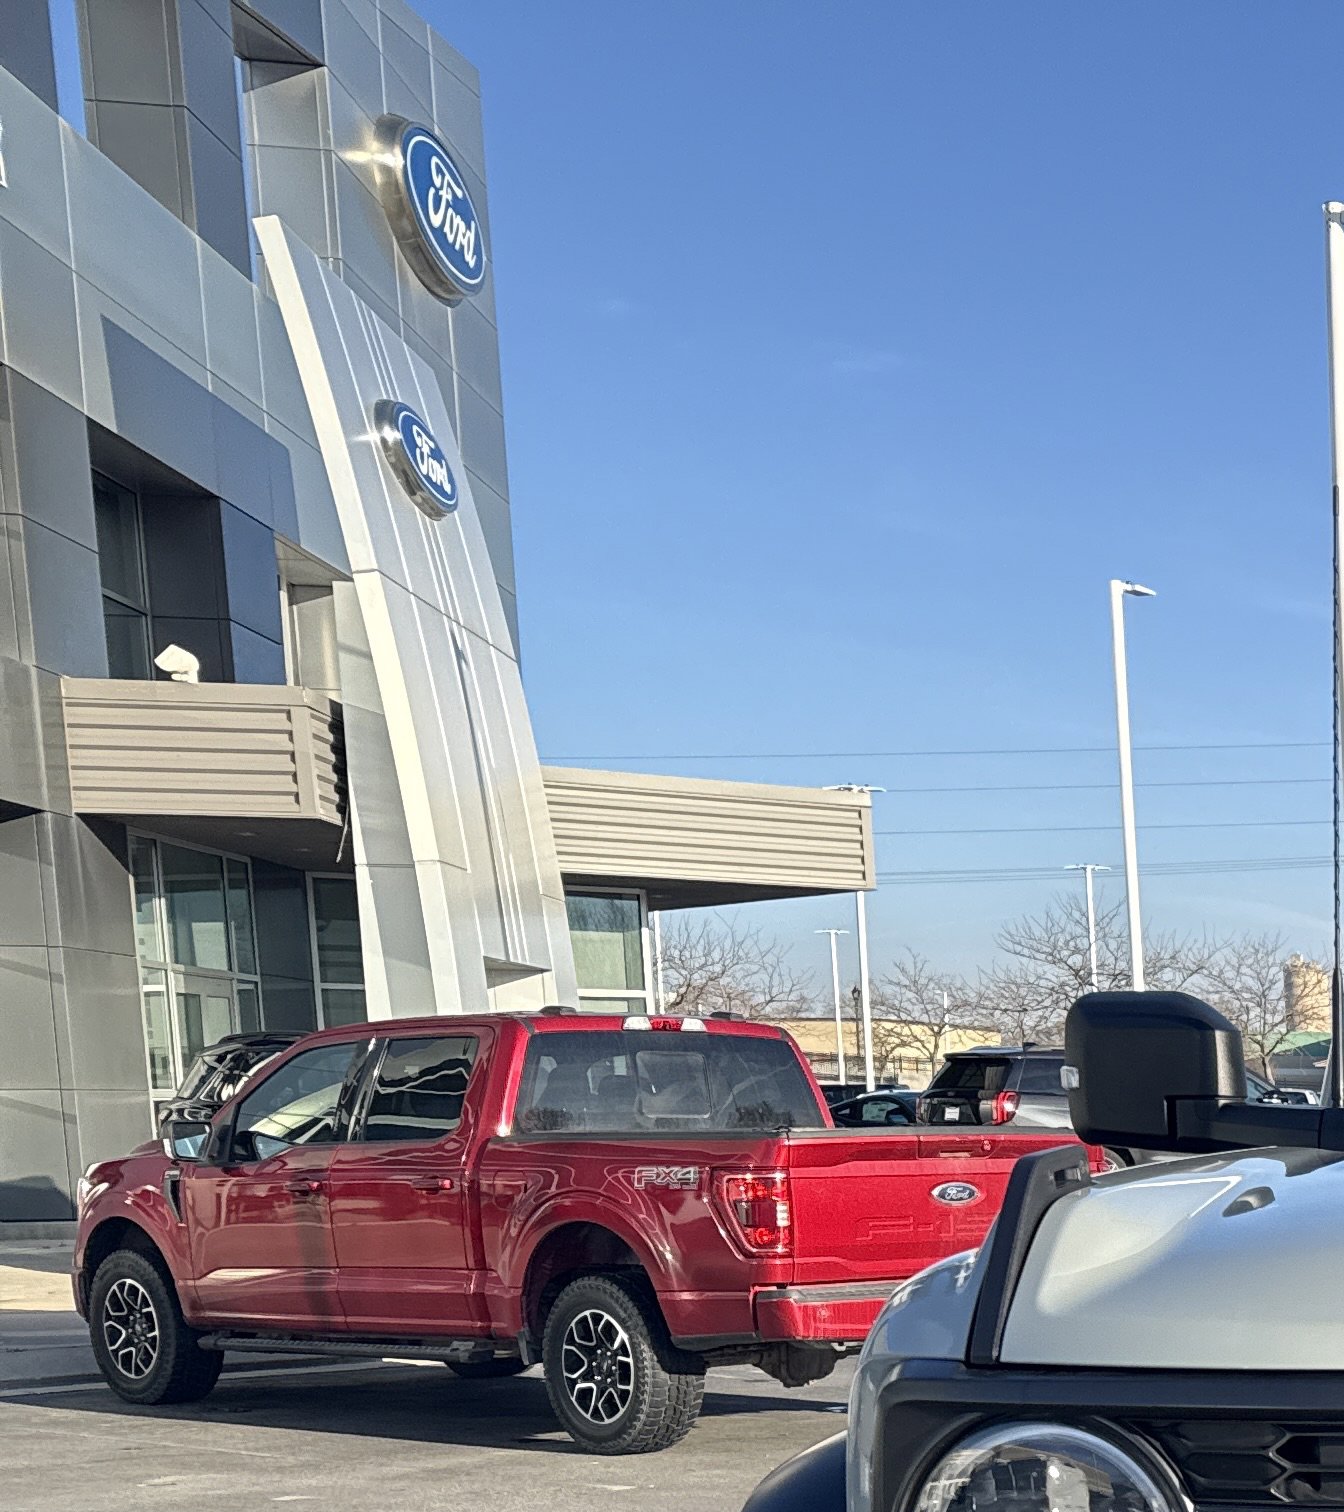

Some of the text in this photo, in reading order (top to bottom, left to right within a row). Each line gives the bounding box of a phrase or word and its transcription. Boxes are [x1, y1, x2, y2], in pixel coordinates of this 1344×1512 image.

[428, 154, 477, 269] Ford
[412, 424, 452, 495] Ford
[634, 1166, 699, 1190] FX4
[945, 1186, 970, 1200] Ford
